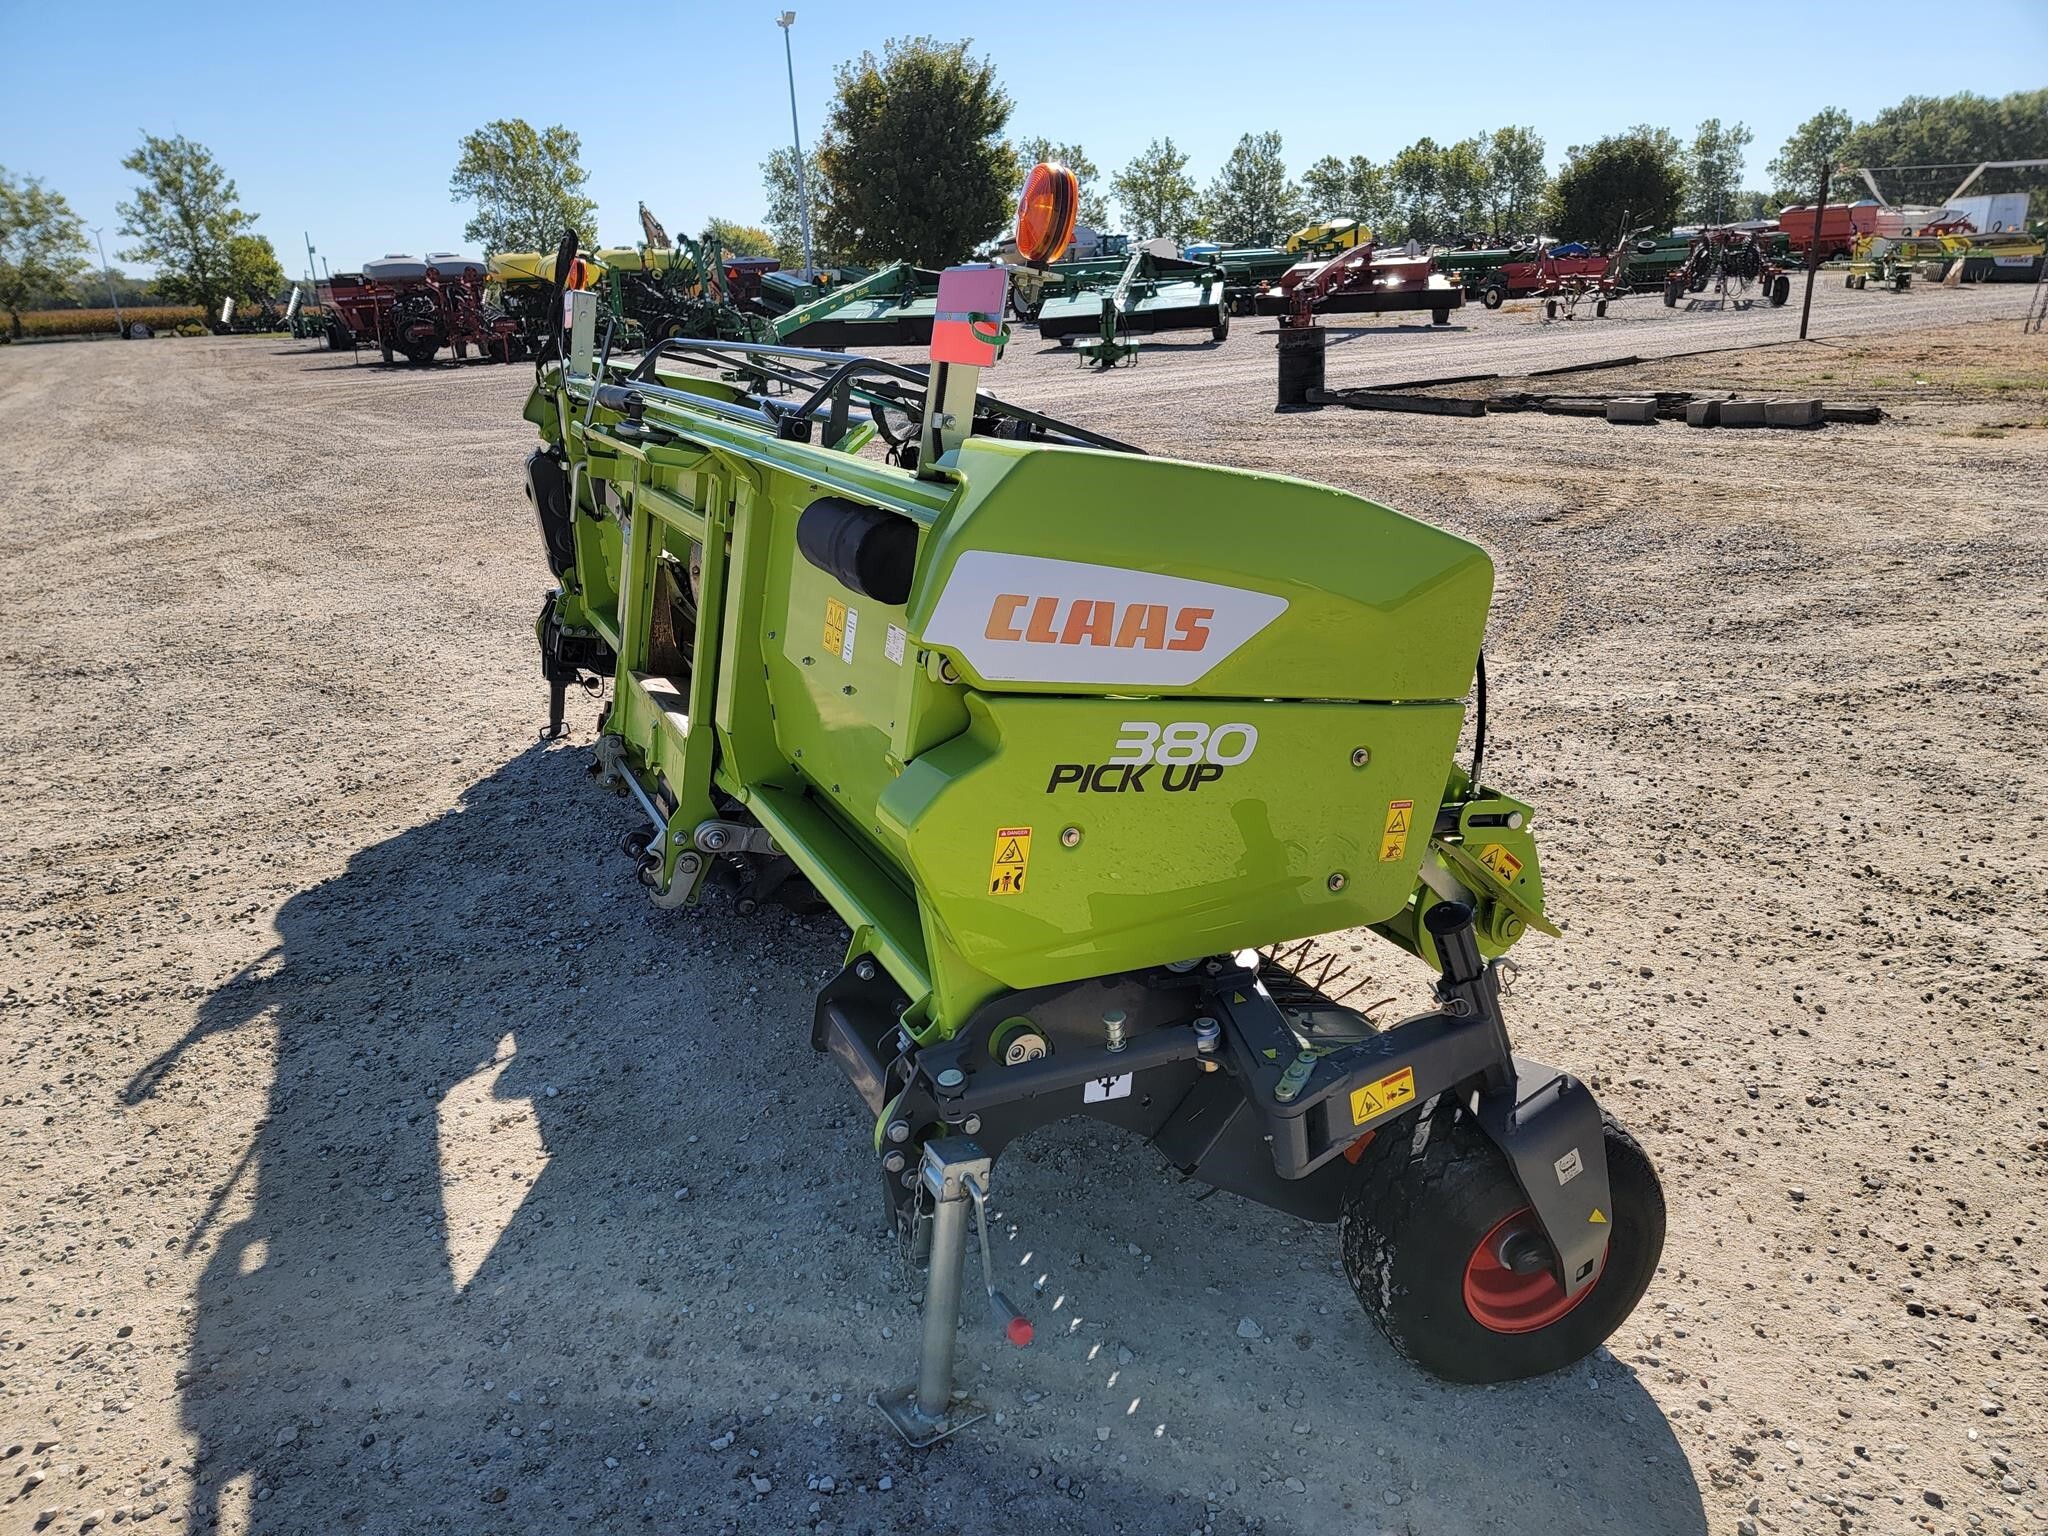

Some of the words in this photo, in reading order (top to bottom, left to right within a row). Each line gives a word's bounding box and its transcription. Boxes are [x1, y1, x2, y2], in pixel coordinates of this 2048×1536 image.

[984, 593, 1215, 652] CLAAS
[1108, 721, 1259, 767] 380
[1046, 764, 1153, 793] PICK
[1161, 763, 1224, 792] UP
